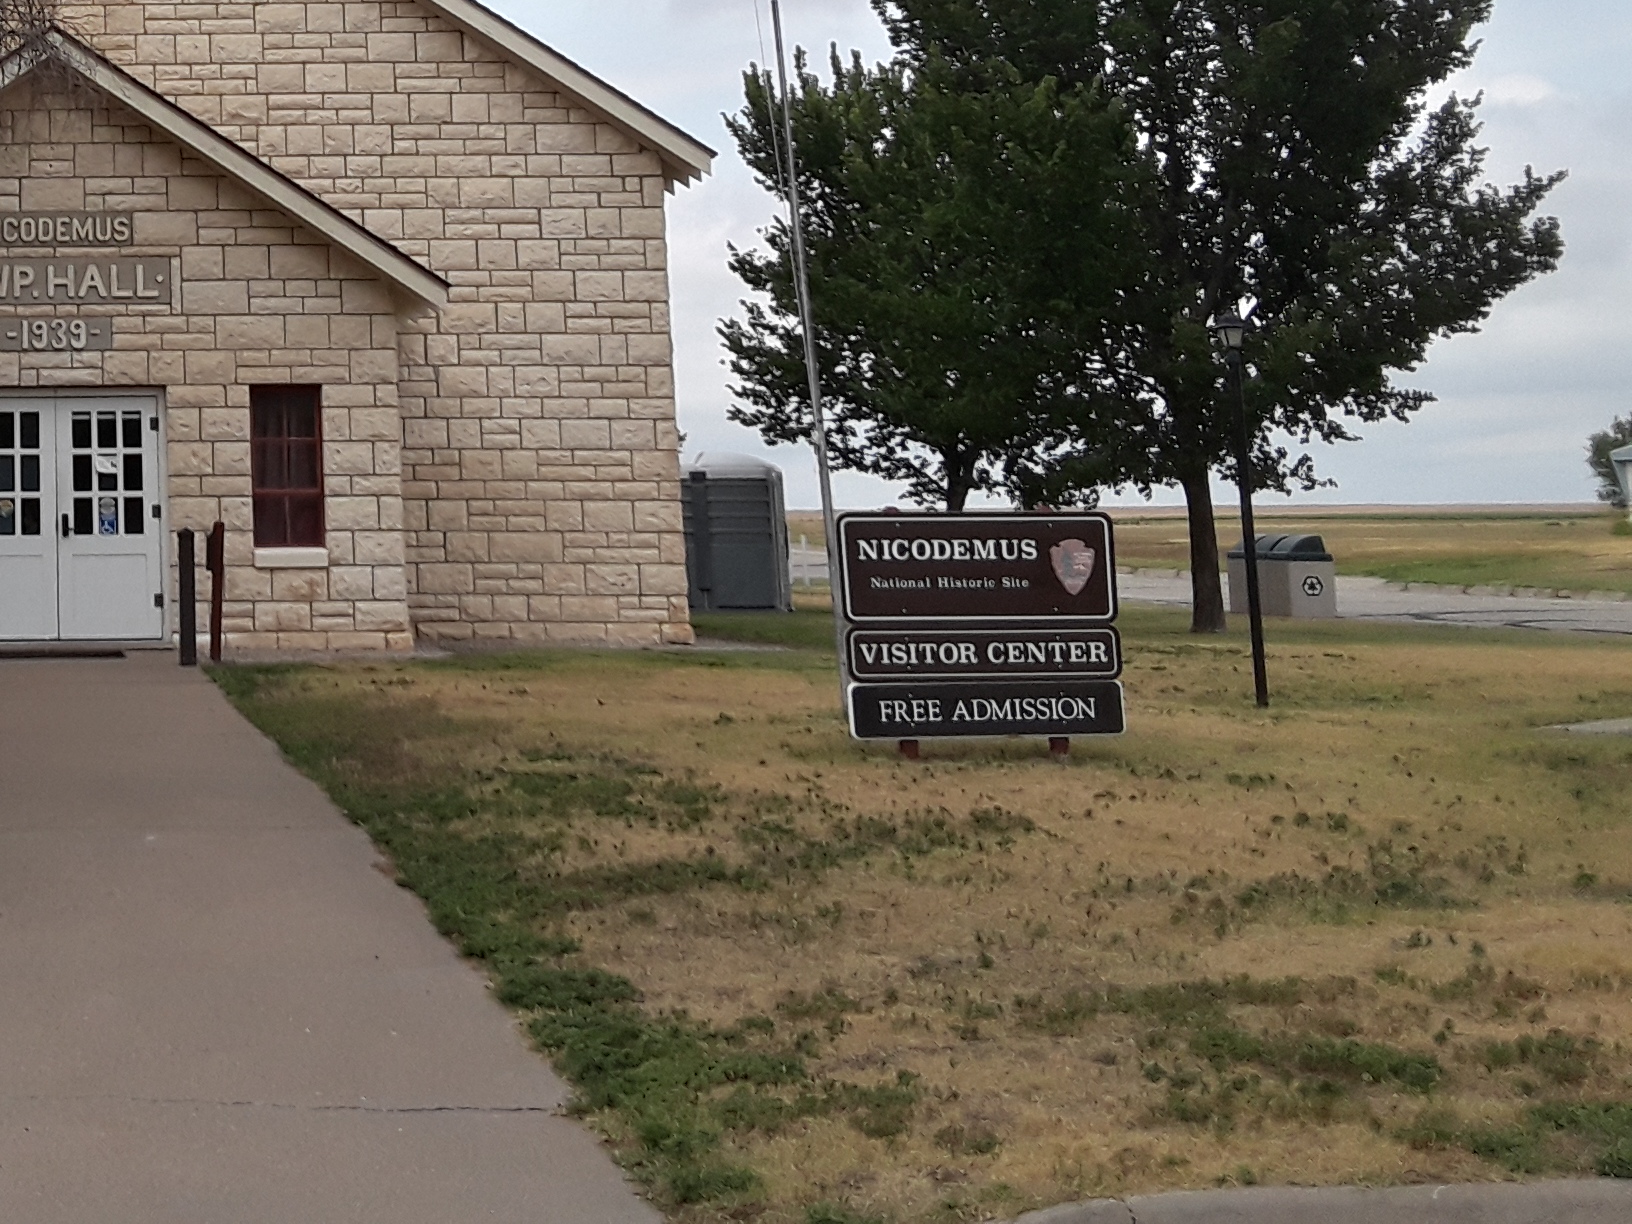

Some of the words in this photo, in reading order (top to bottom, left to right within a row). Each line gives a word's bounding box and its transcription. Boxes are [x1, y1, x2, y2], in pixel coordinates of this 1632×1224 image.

[857, 539, 1038, 560] NICODEMUS
[870, 577, 931, 589] National
[937, 577, 996, 589] Historic
[1001, 577, 1030, 589] Site
[859, 643, 979, 665] VISITOR
[987, 642, 1109, 664] CENTER
[878, 700, 943, 723] FREE
[951, 697, 1096, 720] ADMISSION
